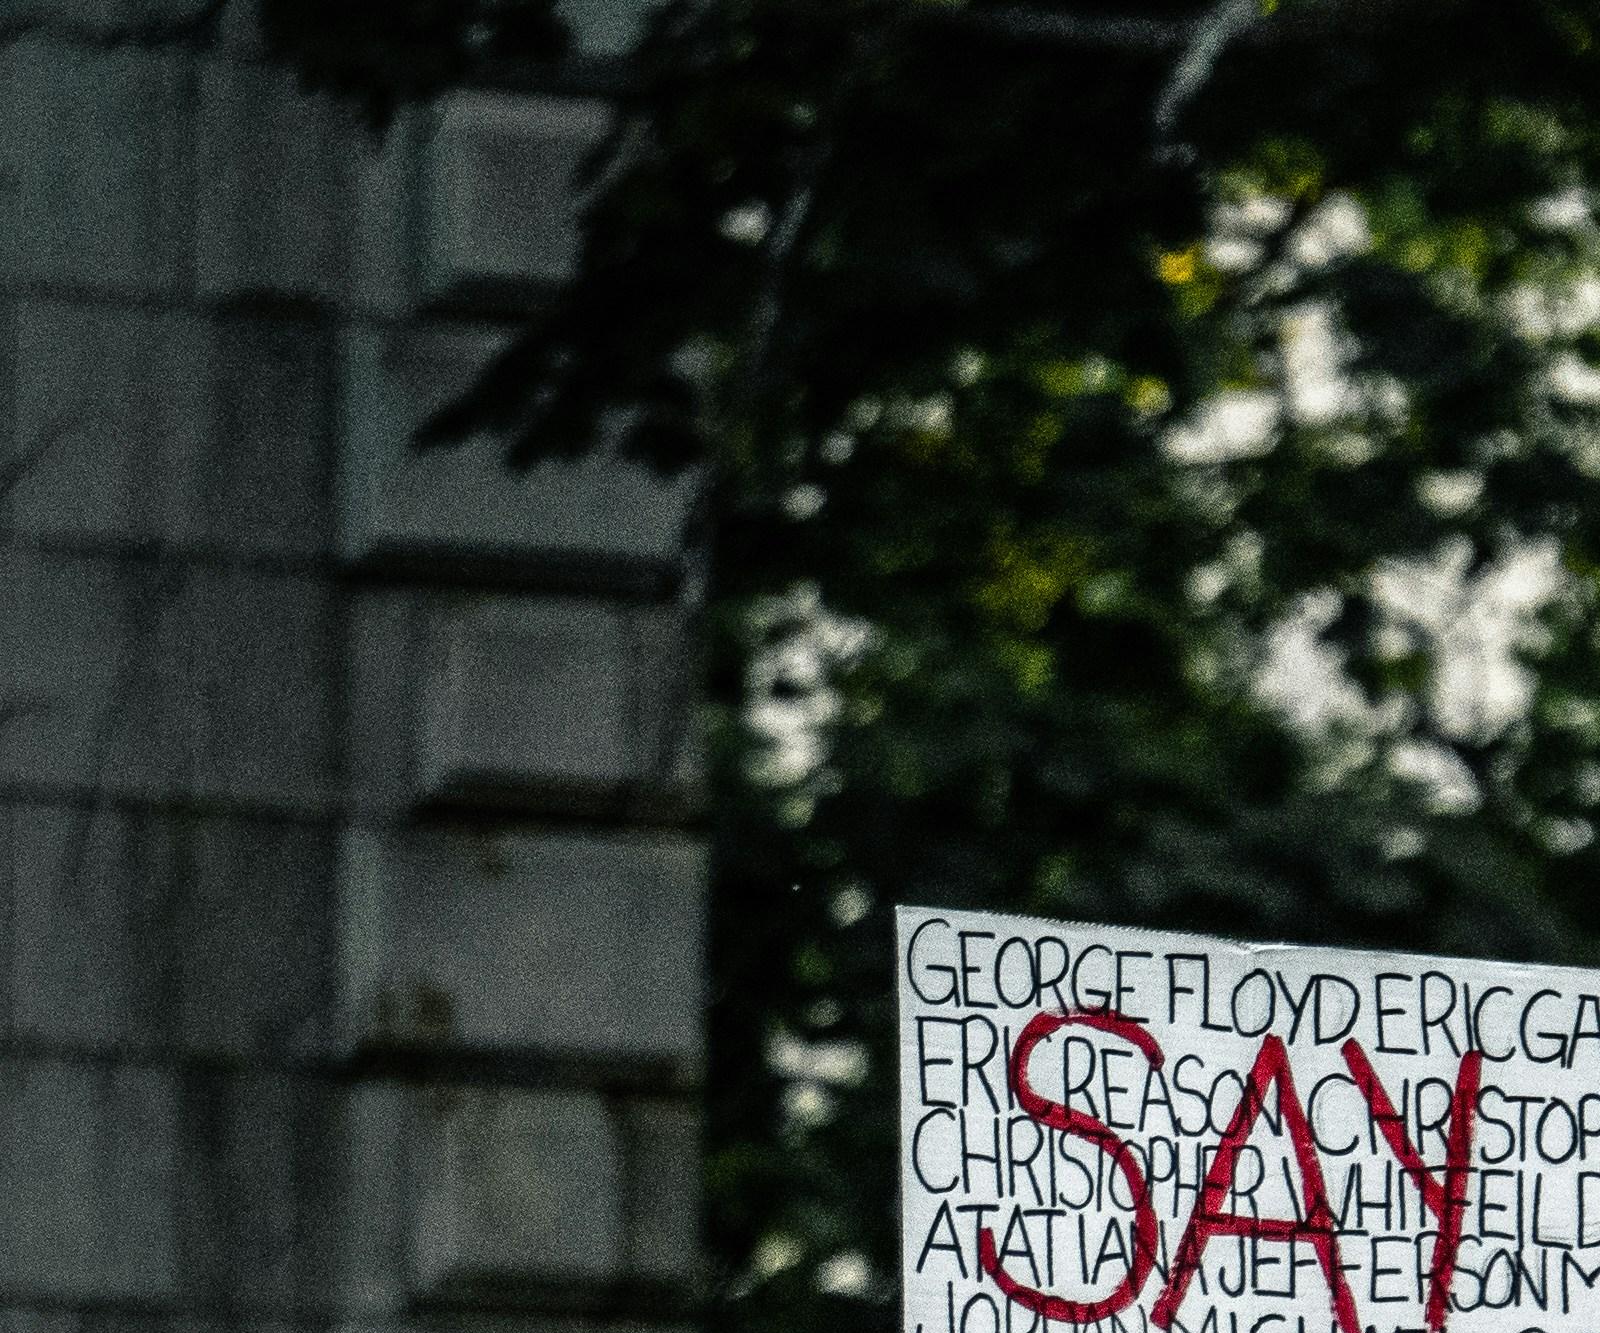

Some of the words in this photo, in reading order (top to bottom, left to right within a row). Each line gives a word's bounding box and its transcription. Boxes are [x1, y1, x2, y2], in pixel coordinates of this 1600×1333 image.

[907, 917, 1152, 1023] GEORGE
[1165, 952, 1360, 1045] FLOYD
[1064, 1035, 1285, 1138] REASON
[911, 1107, 1264, 1234] CHRISTOPHER
